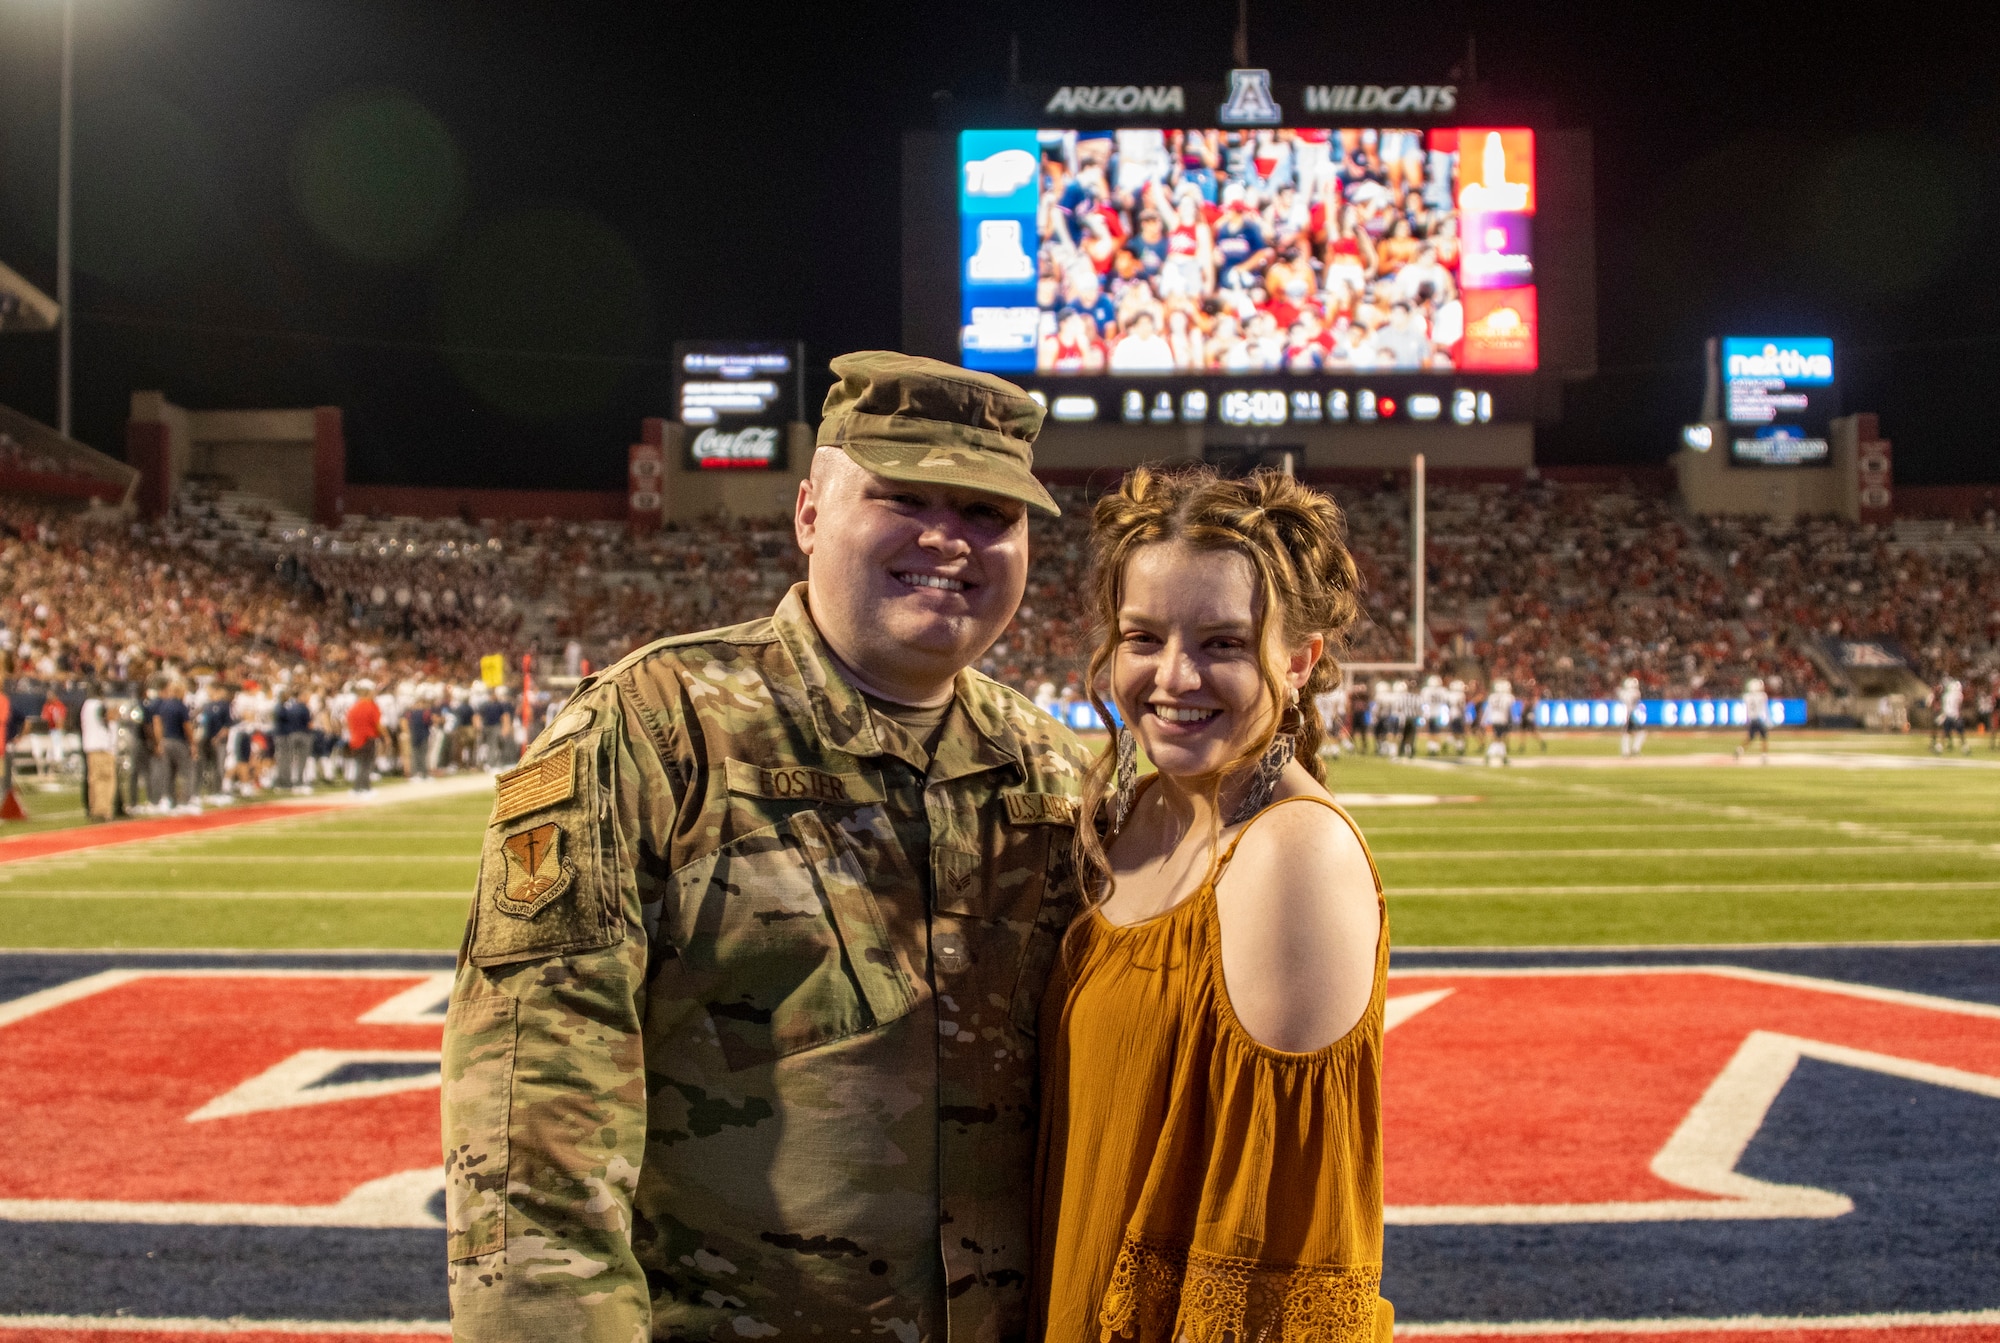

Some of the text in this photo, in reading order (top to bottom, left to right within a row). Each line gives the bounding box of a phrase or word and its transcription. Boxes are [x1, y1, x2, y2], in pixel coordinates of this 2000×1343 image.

[1046, 86, 1184, 113] ARIZONA
[1221, 68, 1281, 123] A
[1304, 85, 1458, 112] WILDCATS
[1222, 391, 1287, 424] 15:00
[1453, 389, 1492, 424] 21
[1663, 702, 1786, 726] CASINS
[759, 770, 845, 799] FOSTER
